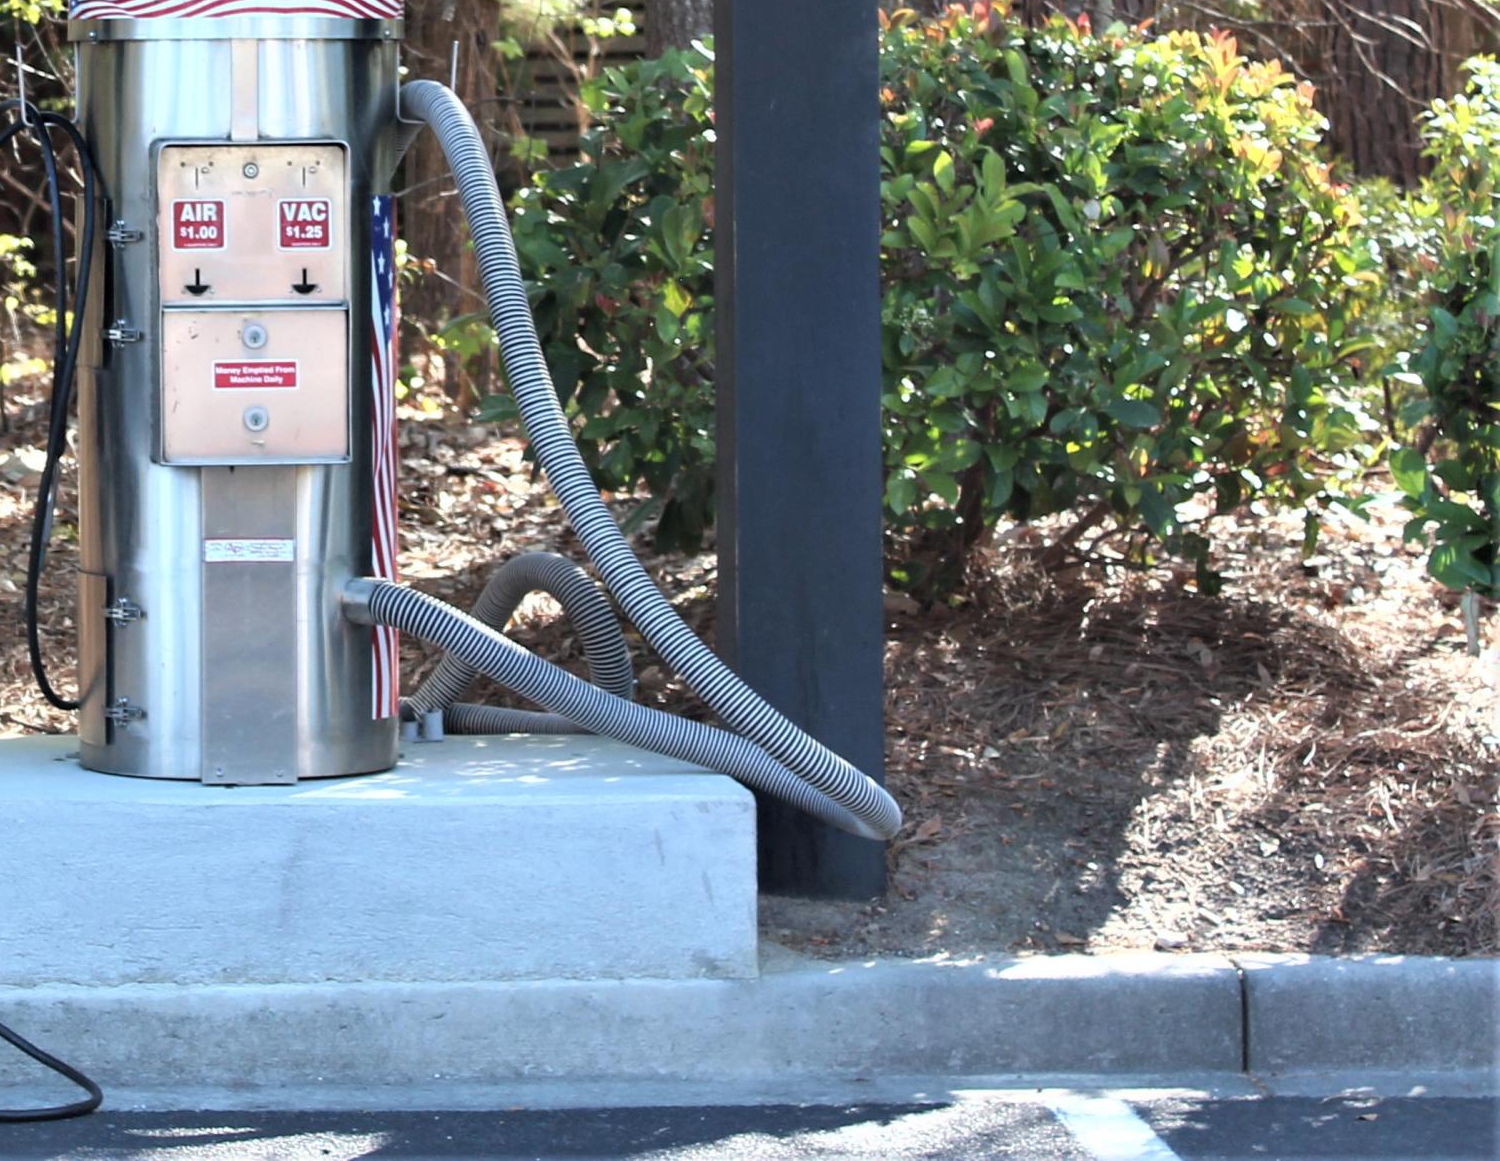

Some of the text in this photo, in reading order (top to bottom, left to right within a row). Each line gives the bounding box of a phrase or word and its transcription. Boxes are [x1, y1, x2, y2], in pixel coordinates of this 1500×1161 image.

[180, 202, 217, 222] AIR
[282, 202, 327, 222] VAC
[180, 225, 217, 239] $1.00
[285, 225, 323, 239] $1.25
